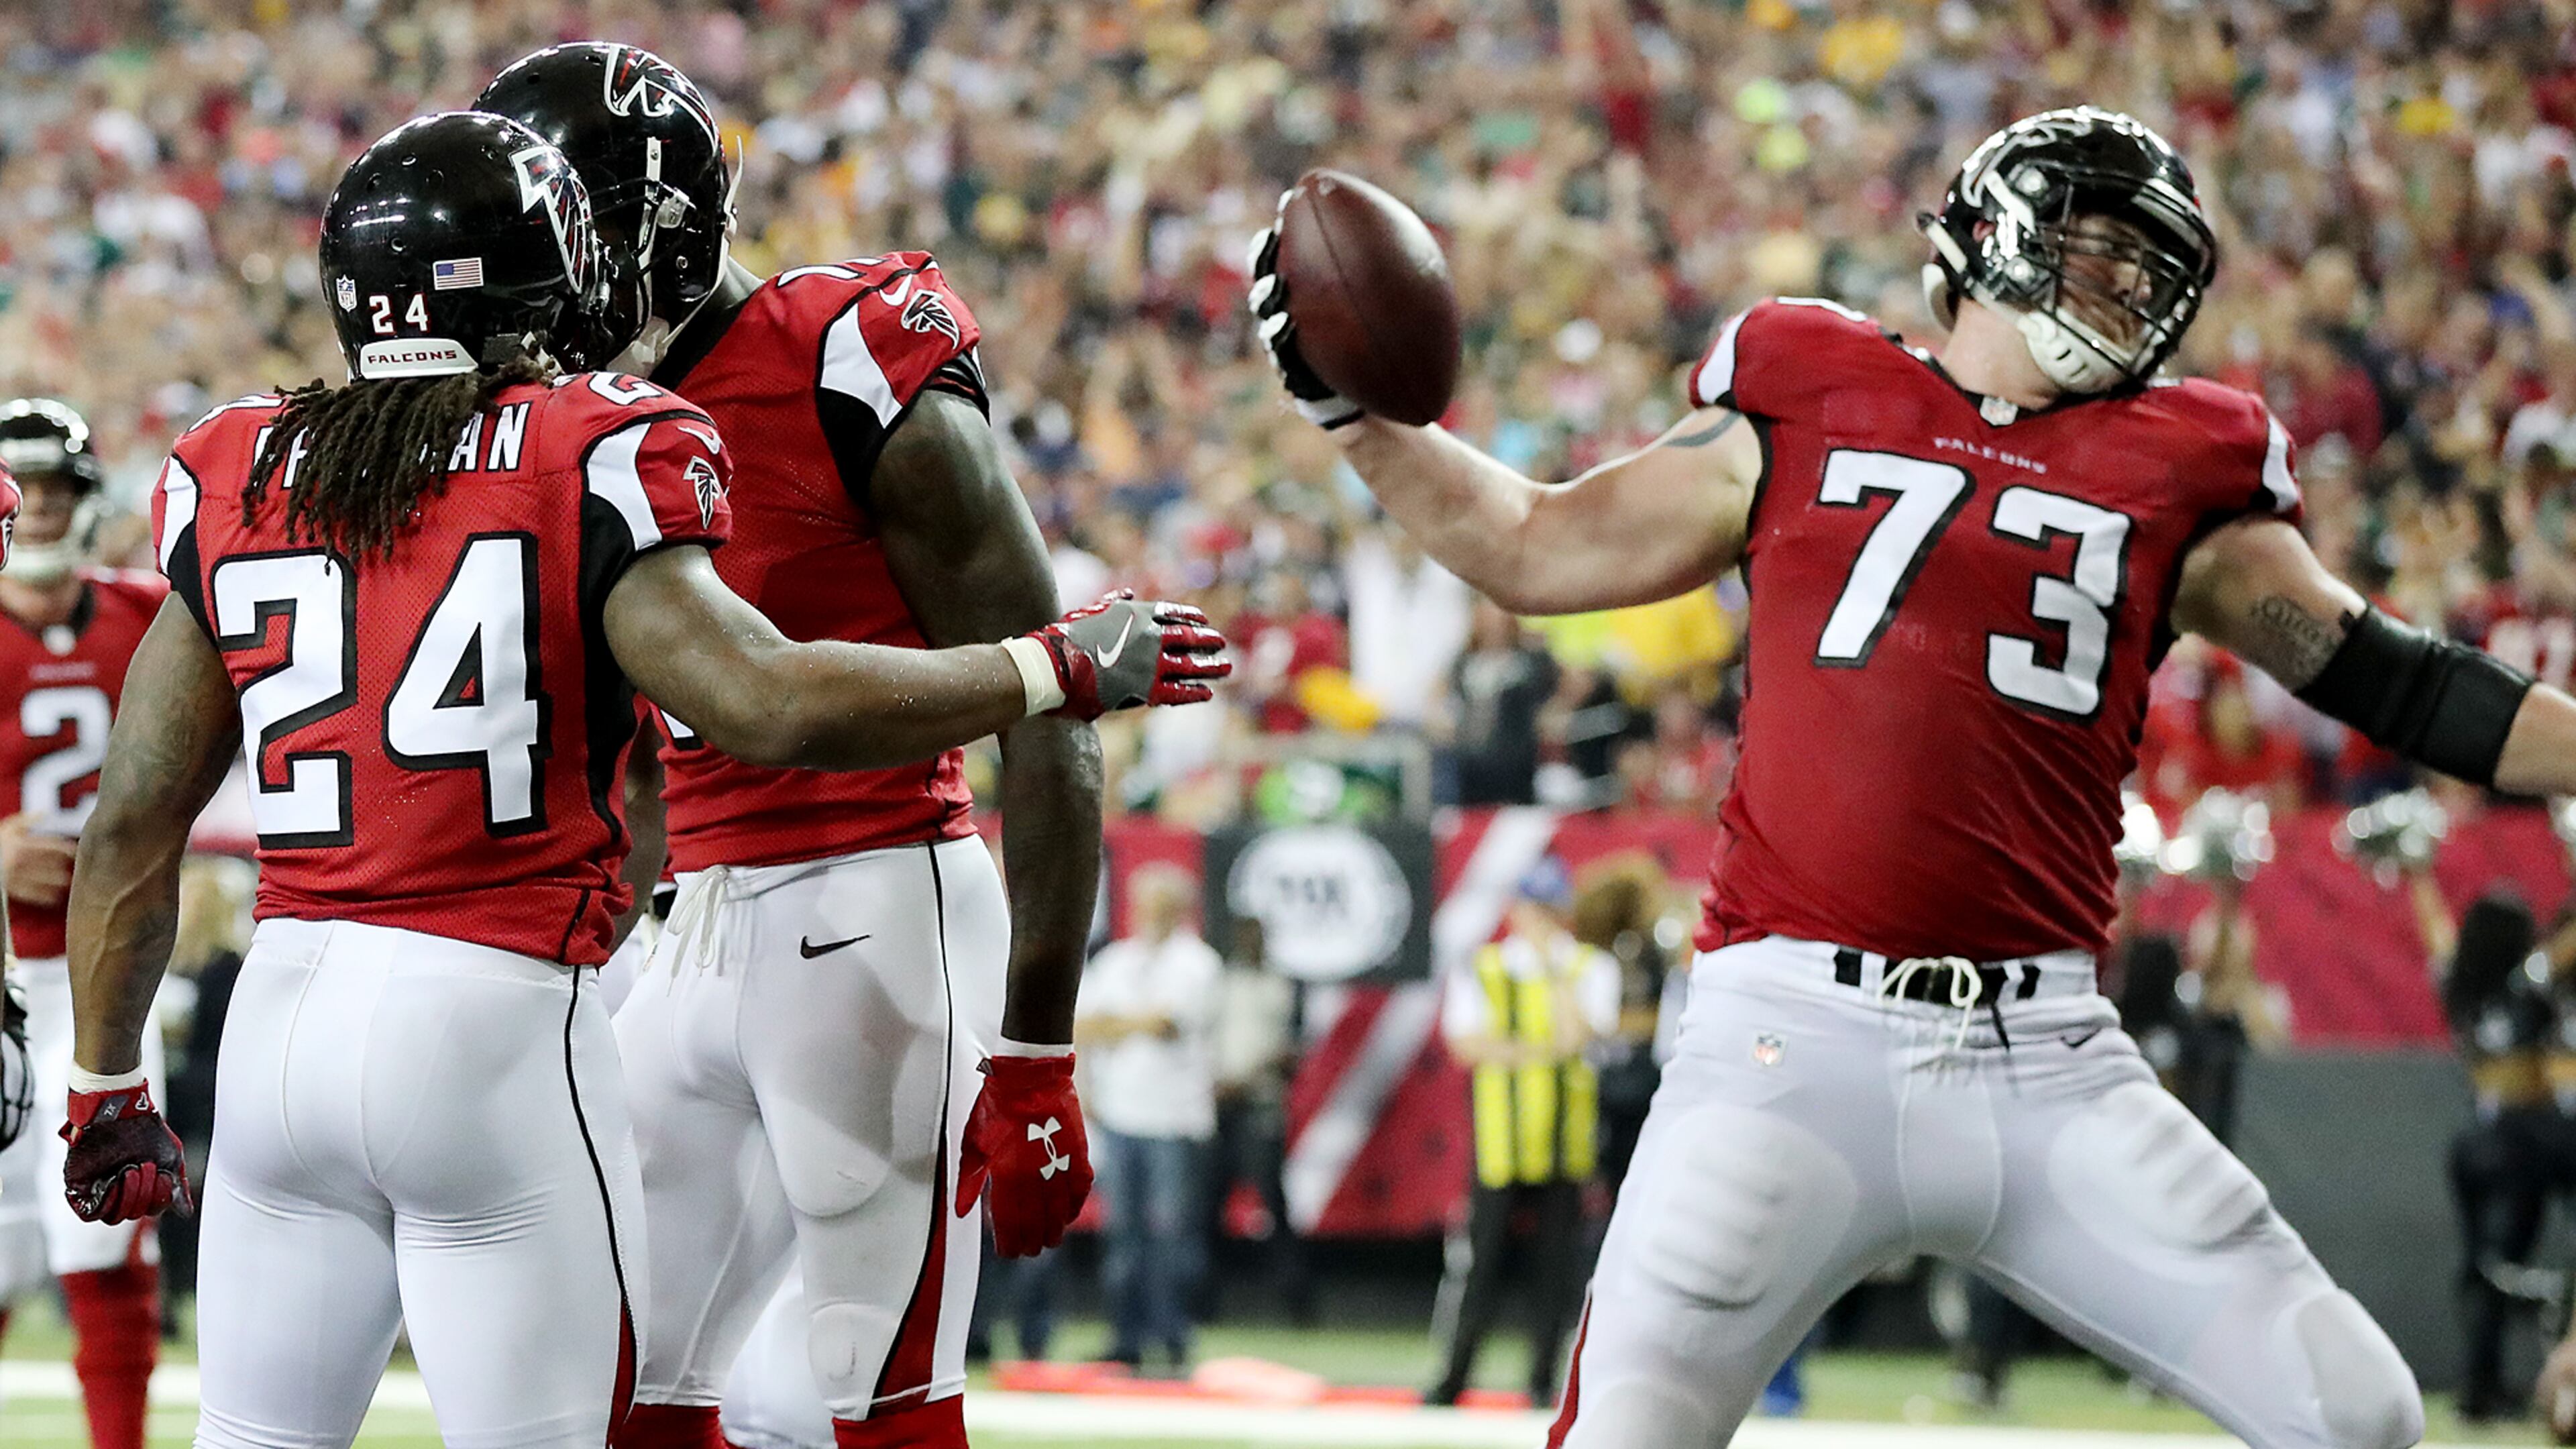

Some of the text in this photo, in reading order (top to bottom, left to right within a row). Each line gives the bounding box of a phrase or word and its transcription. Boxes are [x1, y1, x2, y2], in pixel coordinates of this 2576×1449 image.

[367, 350, 458, 364] FALCONS
[368, 292, 431, 335] 24
[1814, 449, 2132, 721] 73
[19, 686, 112, 838] 2
[211, 531, 551, 849] 24
